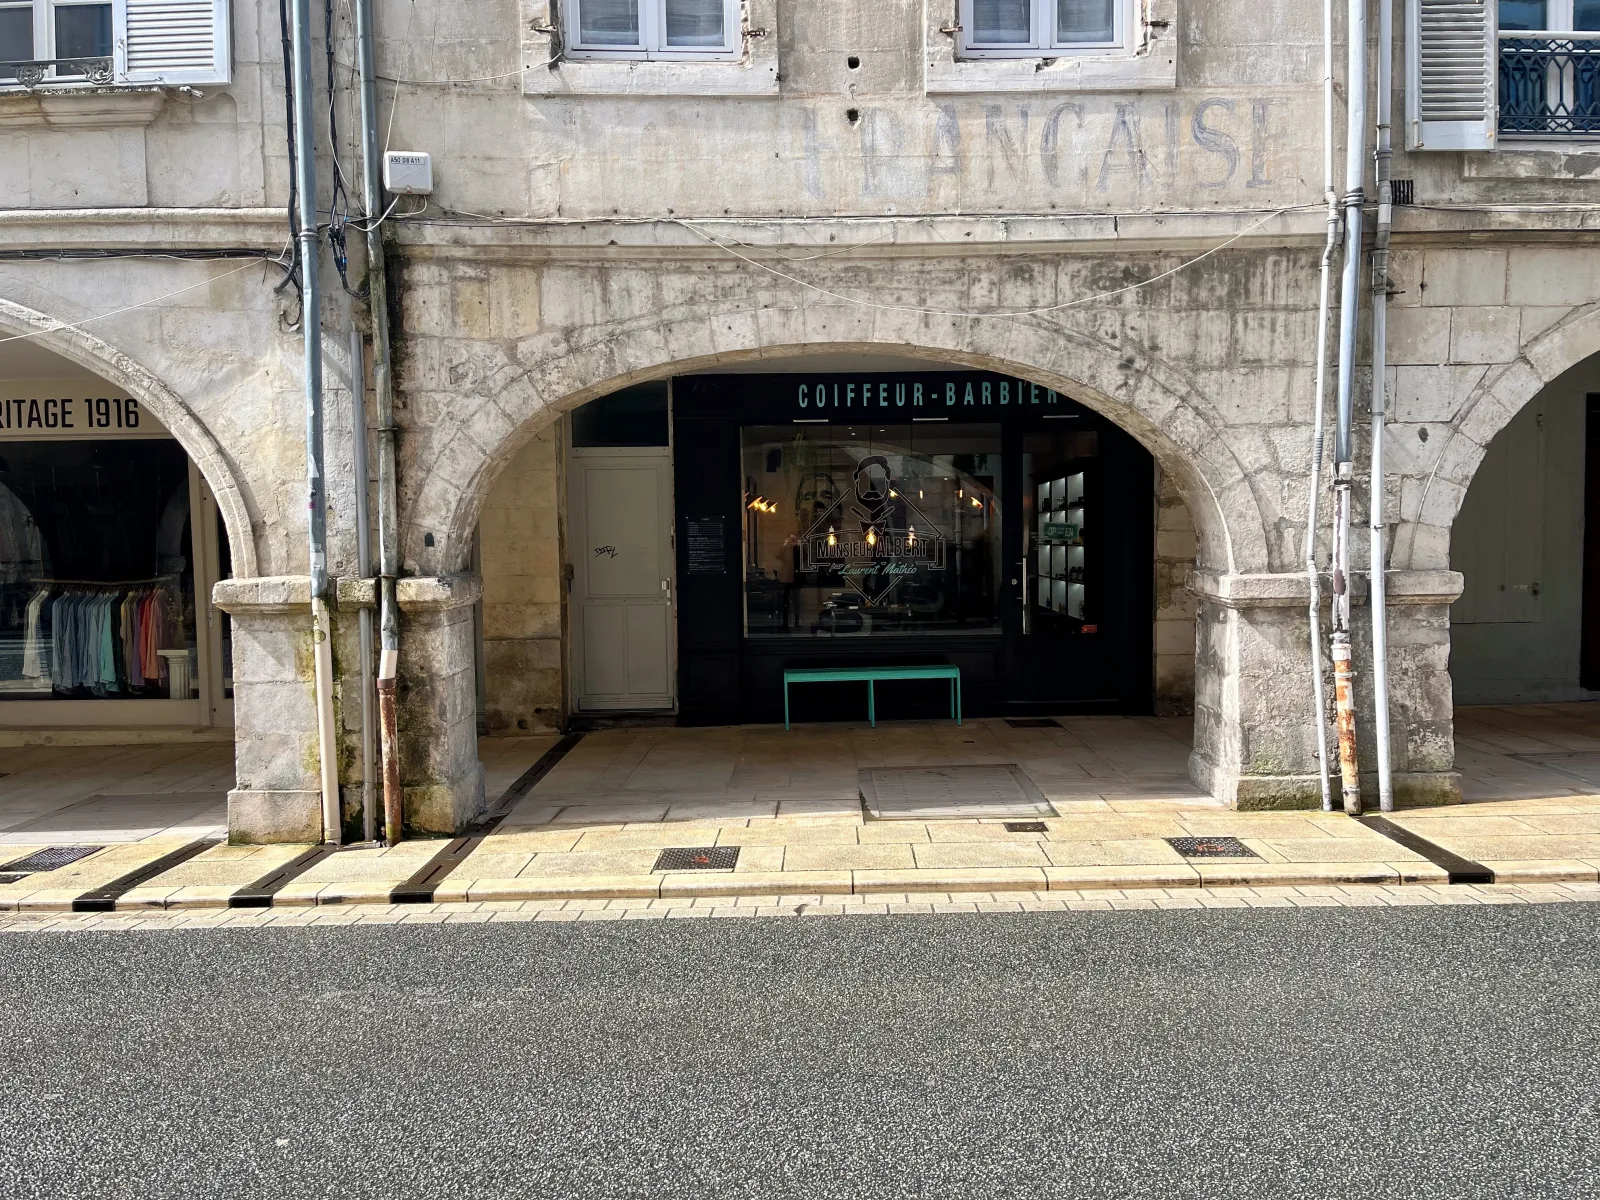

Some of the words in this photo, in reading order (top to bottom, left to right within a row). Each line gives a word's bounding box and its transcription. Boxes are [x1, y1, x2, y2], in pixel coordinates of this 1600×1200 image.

[798, 381, 1058, 408] COIFFEUR-BARBIER
[84, 398, 140, 428] 1916
[876, 536, 929, 558] ALBERT
[838, 564, 881, 575] Laurent
[882, 563, 917, 575] Mathéo
